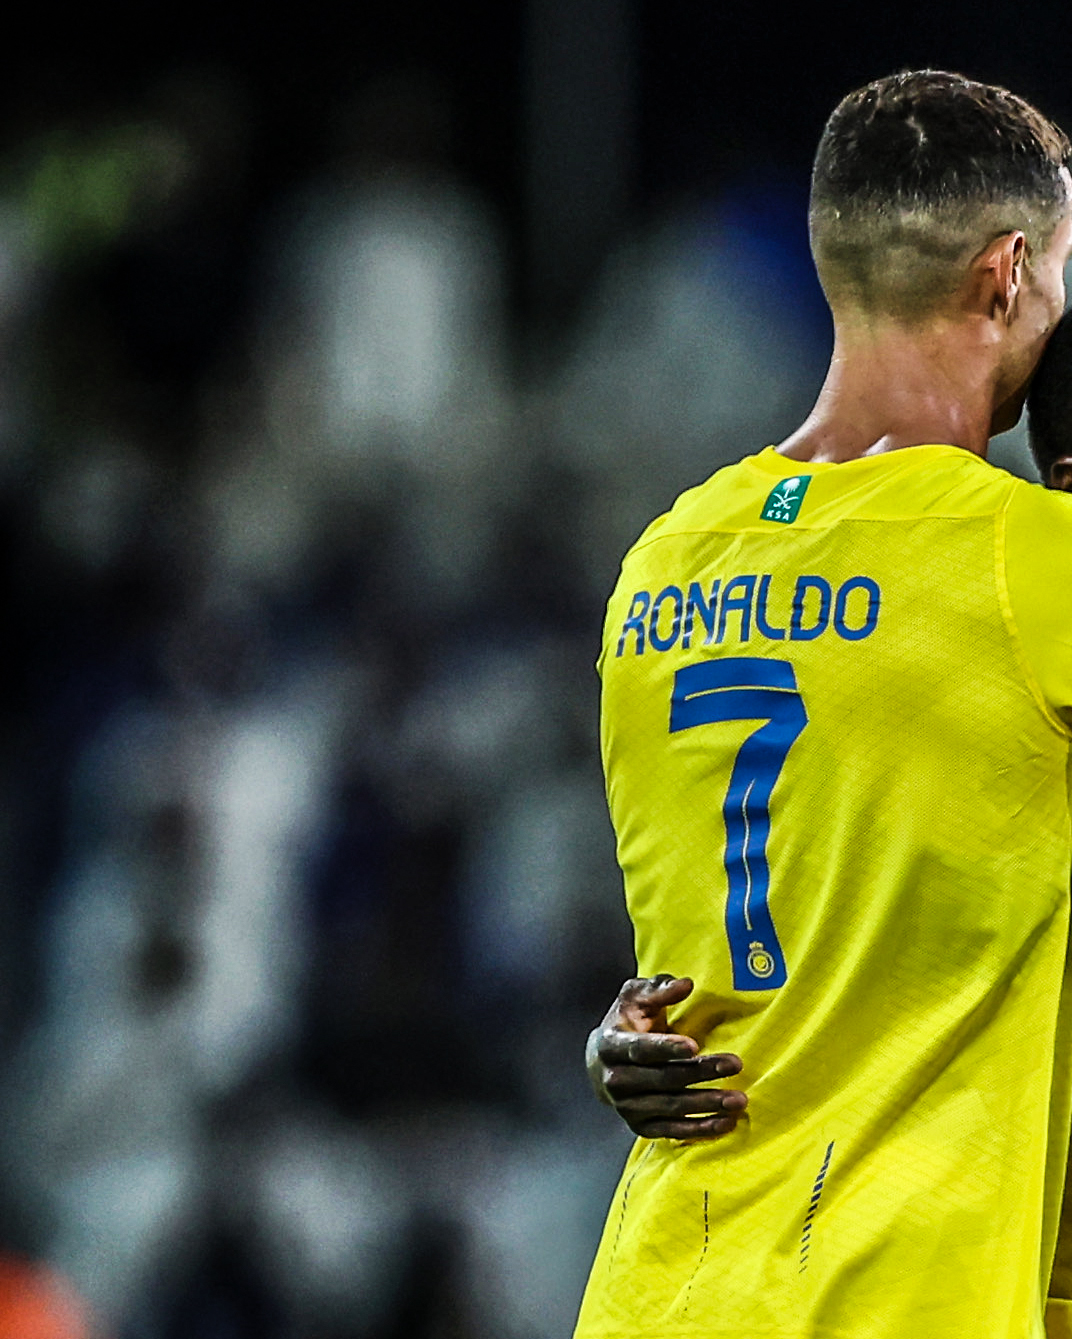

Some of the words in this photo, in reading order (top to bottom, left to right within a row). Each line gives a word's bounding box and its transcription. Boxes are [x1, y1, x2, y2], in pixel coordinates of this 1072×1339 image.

[766, 509, 790, 521] KSA
[615, 575, 881, 657] RONALDO
[669, 657, 810, 991] 7
